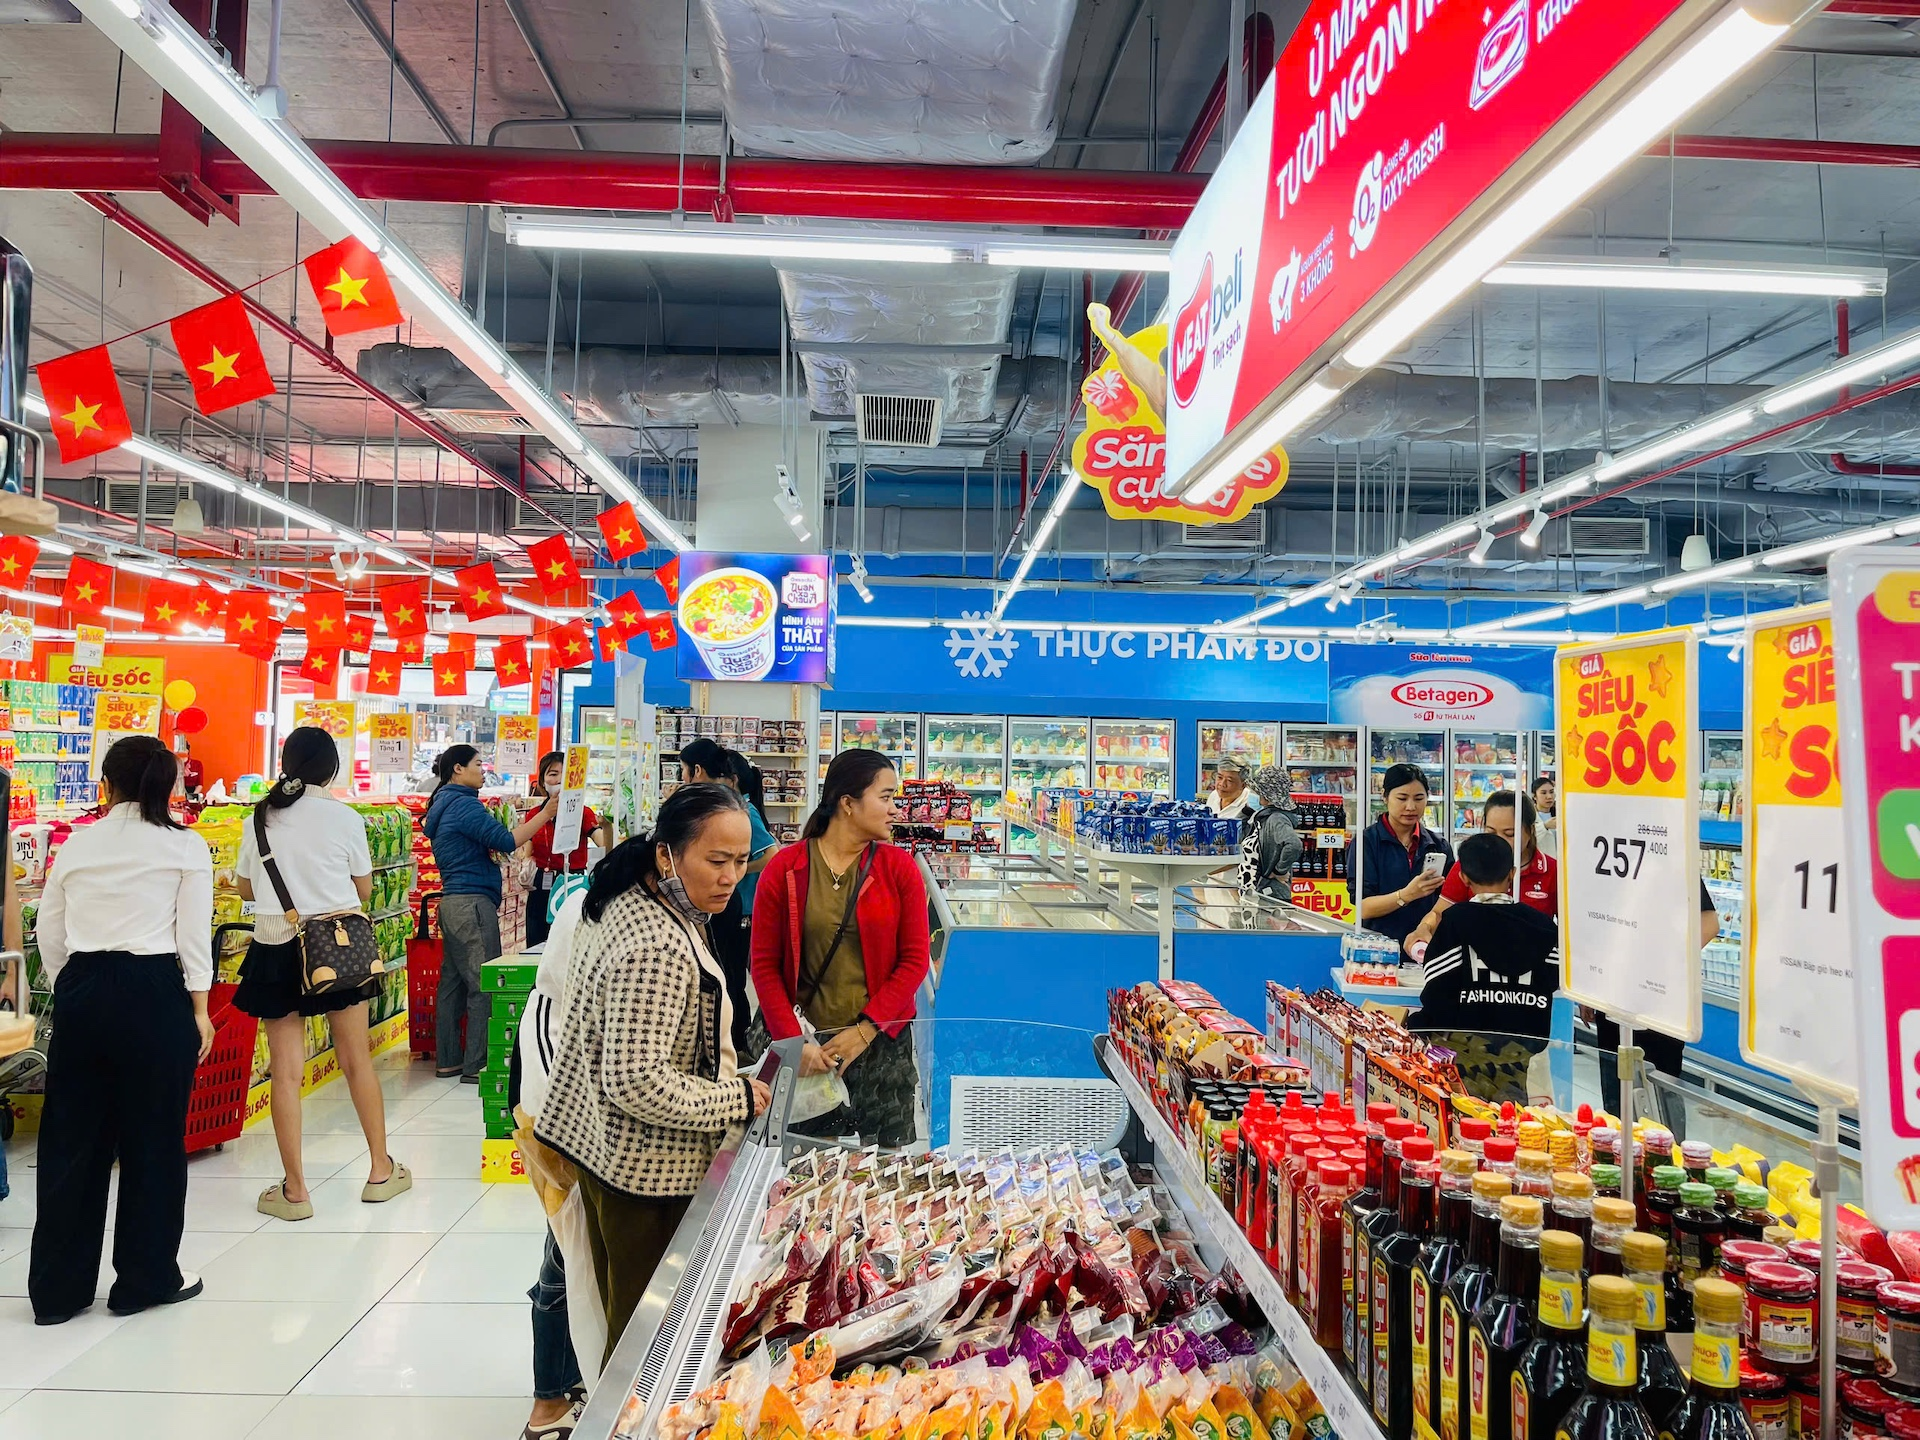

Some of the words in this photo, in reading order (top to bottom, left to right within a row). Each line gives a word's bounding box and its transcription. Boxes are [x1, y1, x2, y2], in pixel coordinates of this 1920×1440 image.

[1309, 23, 1325, 98] Ủ
[1277, 110, 1325, 220] TƯƠI
[1330, 0, 1408, 151] NGON
[1383, 122, 1444, 212] OXY-FRESH
[1300, 280, 1306, 304] 3
[1306, 250, 1333, 298] KHÔNG
[1175, 300, 1209, 382] MEAT
[1213, 246, 1243, 336] Deli
[782, 616, 803, 626] HÌNH
[782, 628, 823, 646] THẬT
[1032, 630, 1136, 665] THỰC
[1789, 627, 1818, 656] GIÁ
[1409, 652, 1429, 662] Sữa
[1580, 655, 1601, 676] GIÁ
[112, 666, 151, 687] SỐC
[1781, 646, 1836, 709] SIÊ
[1406, 686, 1478, 705] Betagen
[1577, 669, 1635, 719] SIÊU
[107, 700, 134, 712] SIÊU
[380, 724, 408, 738] SỐC
[396, 740, 402, 752] 1
[521, 742, 527, 753] 1
[1583, 701, 1677, 788] SỐC
[17, 841, 31, 852] JIN
[1324, 835, 1336, 843] 56
[22, 850, 34, 861] JU
[1593, 835, 1647, 880] 257
[1292, 881, 1311, 892] GIÁ
[1459, 989, 1548, 1009] FASHIONKIDS
[255, 1091, 270, 1113] SỐC
